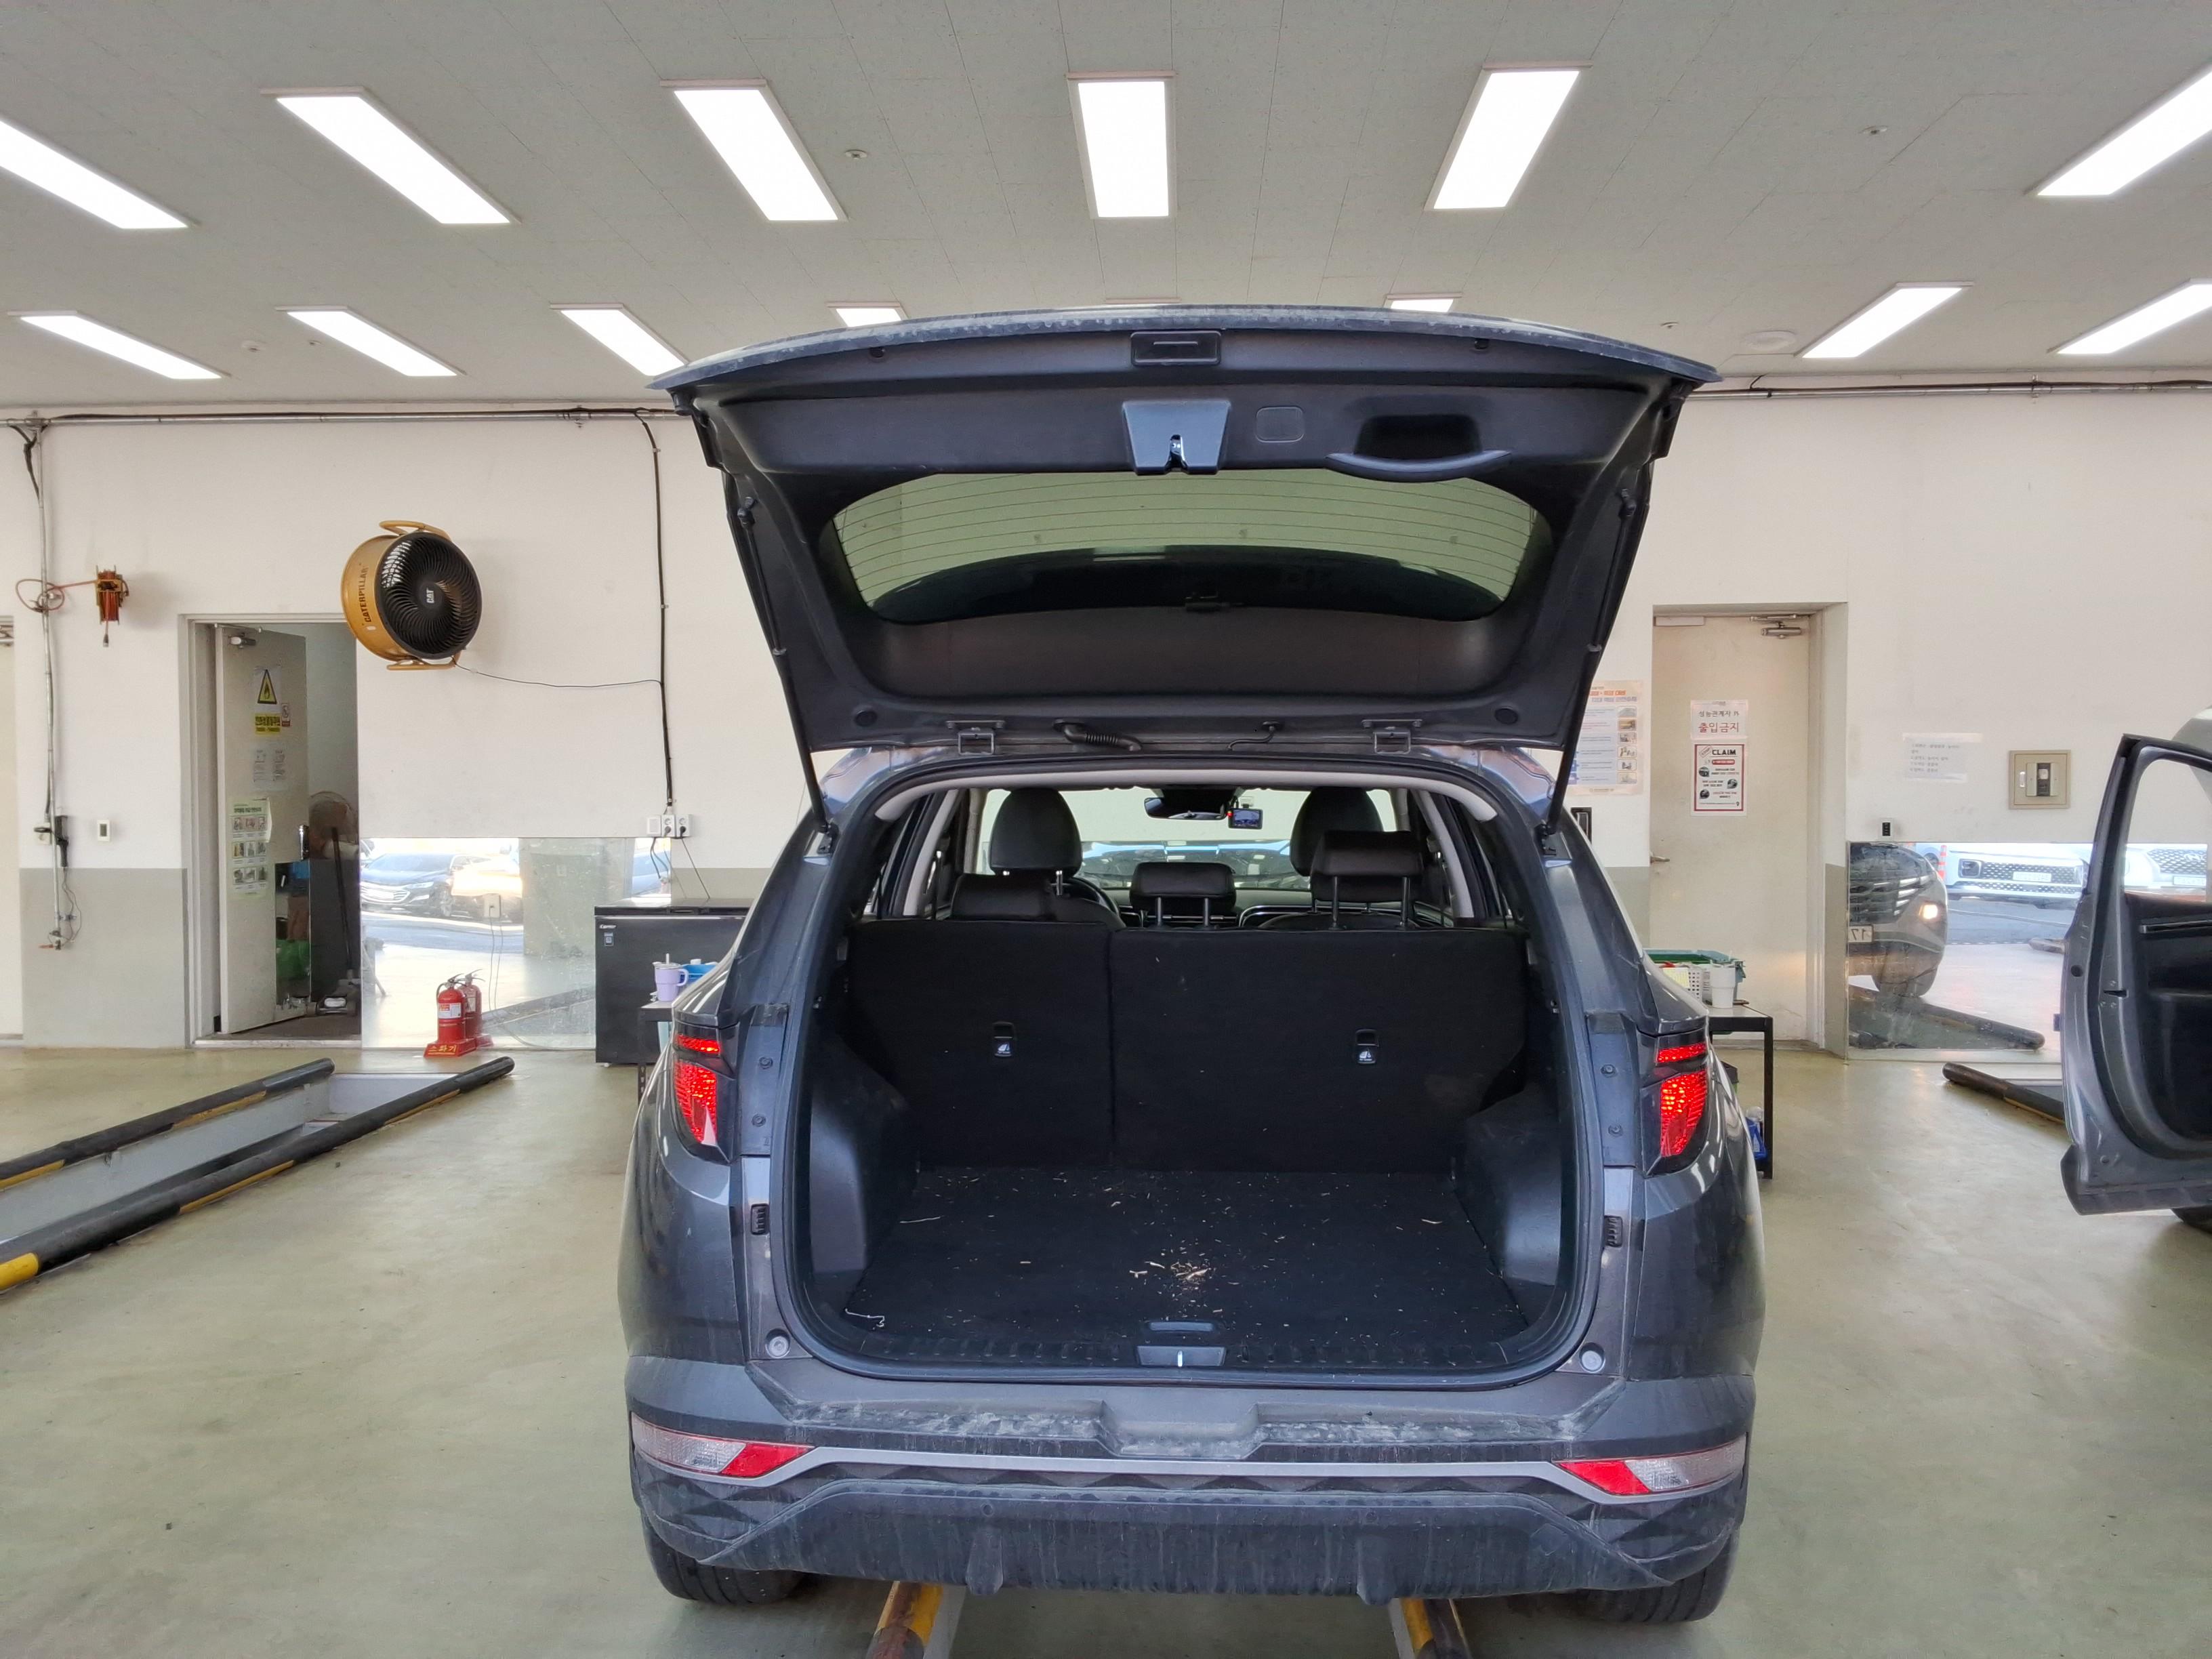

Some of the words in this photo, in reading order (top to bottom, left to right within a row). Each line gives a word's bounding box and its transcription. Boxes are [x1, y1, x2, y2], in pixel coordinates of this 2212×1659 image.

[359, 565, 372, 622] CATERPILLAR
[426, 588, 434, 603] CAT
[1698, 722, 1739, 733] 출입금지
